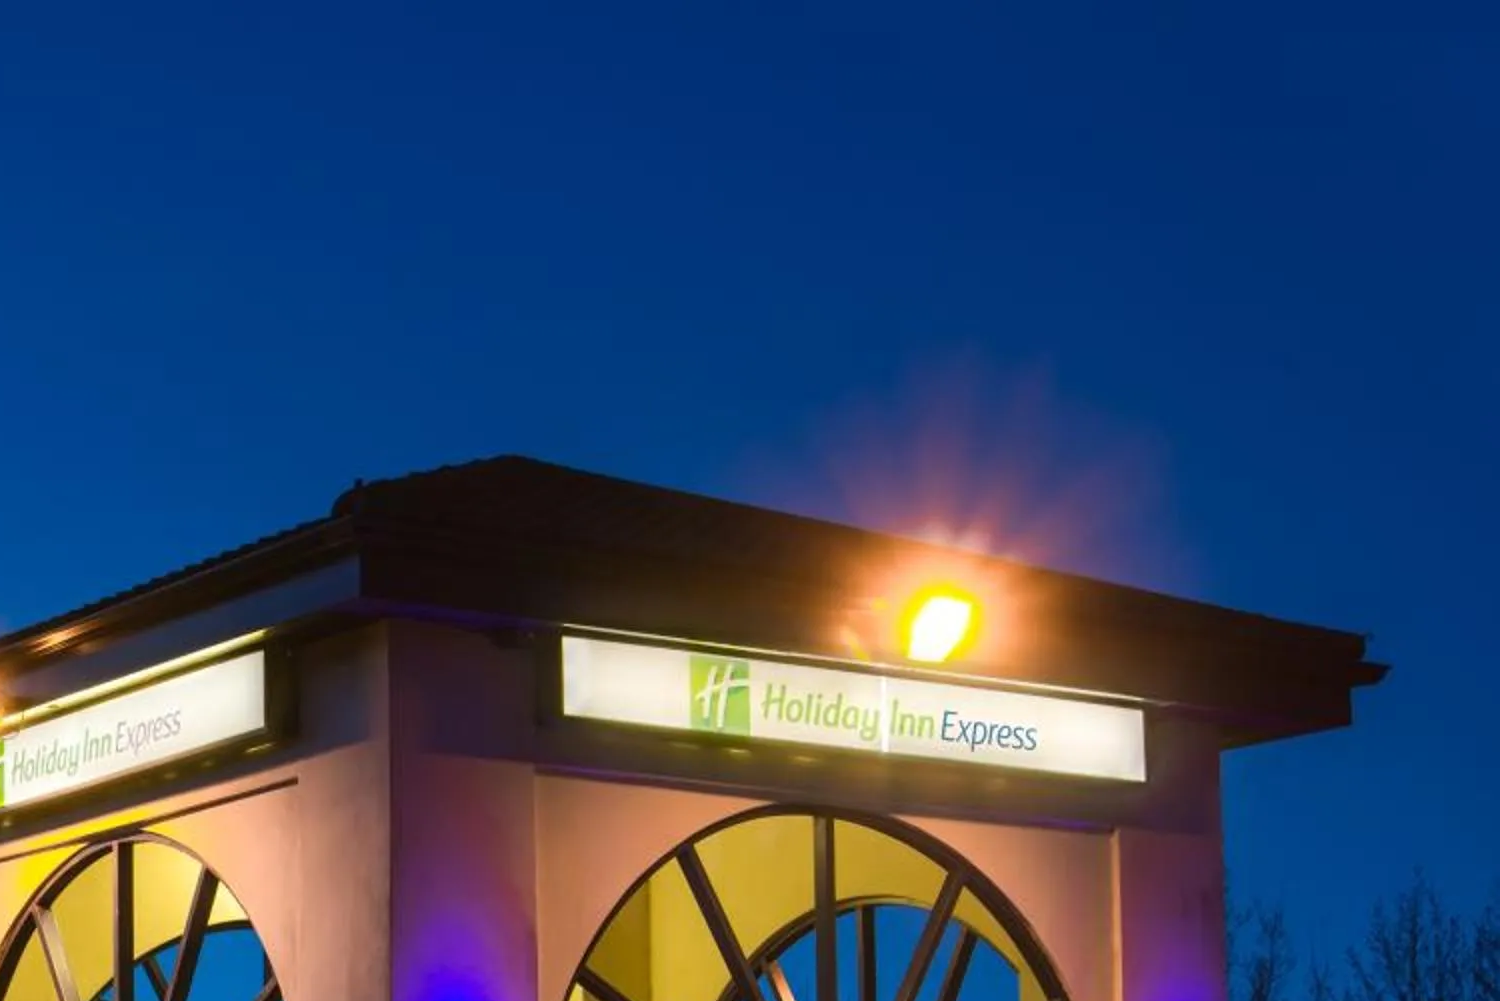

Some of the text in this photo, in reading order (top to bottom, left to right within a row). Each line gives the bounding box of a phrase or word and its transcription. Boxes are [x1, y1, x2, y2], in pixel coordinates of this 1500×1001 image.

[11, 741, 81, 785] Holiday
[82, 727, 112, 763] Inn
[114, 708, 182, 757] Express
[761, 683, 881, 742] Holiday
[889, 698, 935, 740] Inn
[941, 710, 1038, 752] Express
